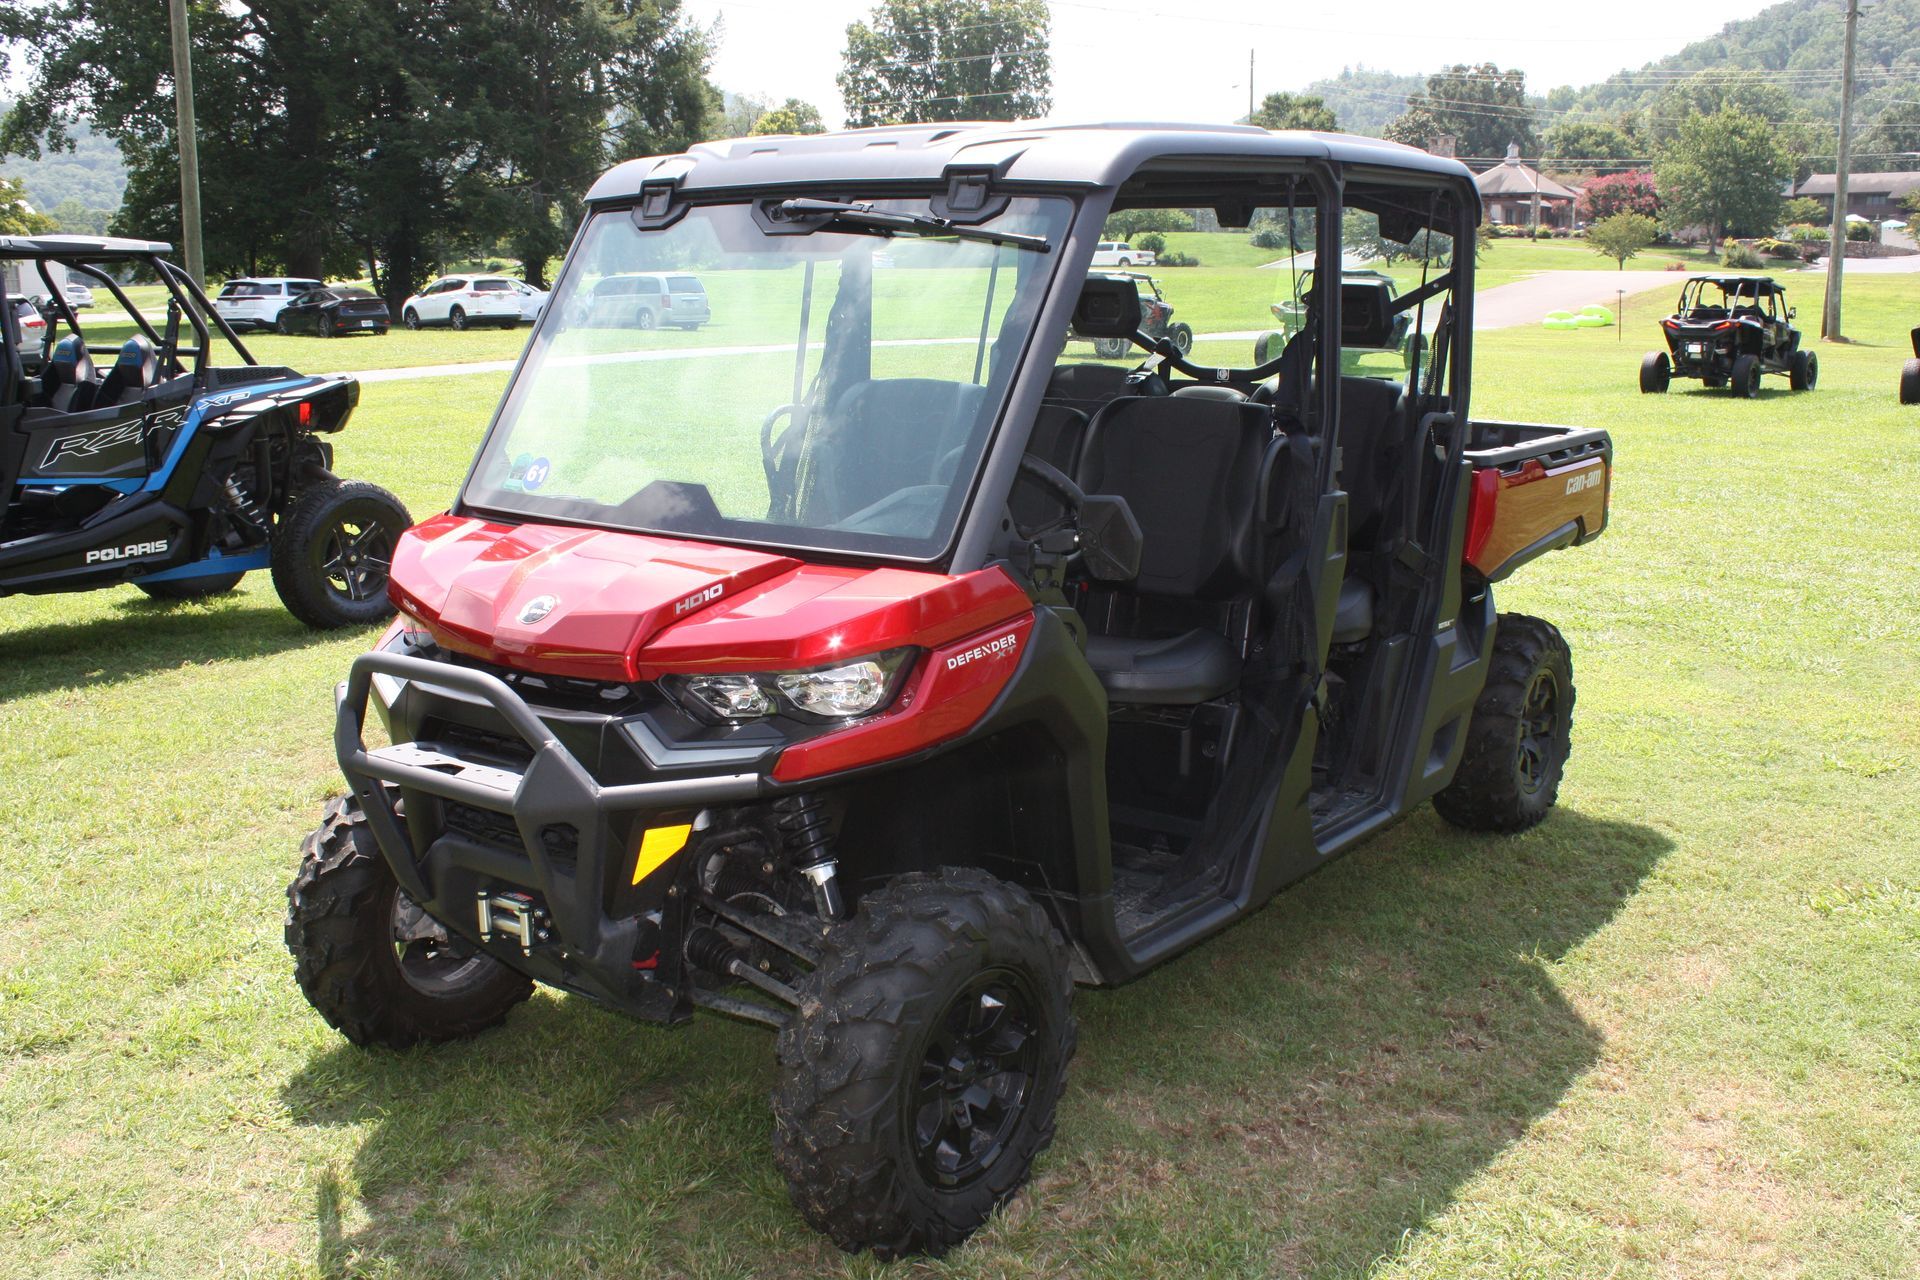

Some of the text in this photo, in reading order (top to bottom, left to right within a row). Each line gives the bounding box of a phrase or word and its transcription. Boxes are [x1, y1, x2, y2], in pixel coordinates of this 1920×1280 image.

[39, 391, 251, 469] RZR XP
[526, 464, 548, 483] 61
[86, 539, 168, 564] POLARIS
[675, 583, 723, 615] HD10
[946, 633, 1017, 670] DEFENDER
[996, 645, 1017, 660] XT
